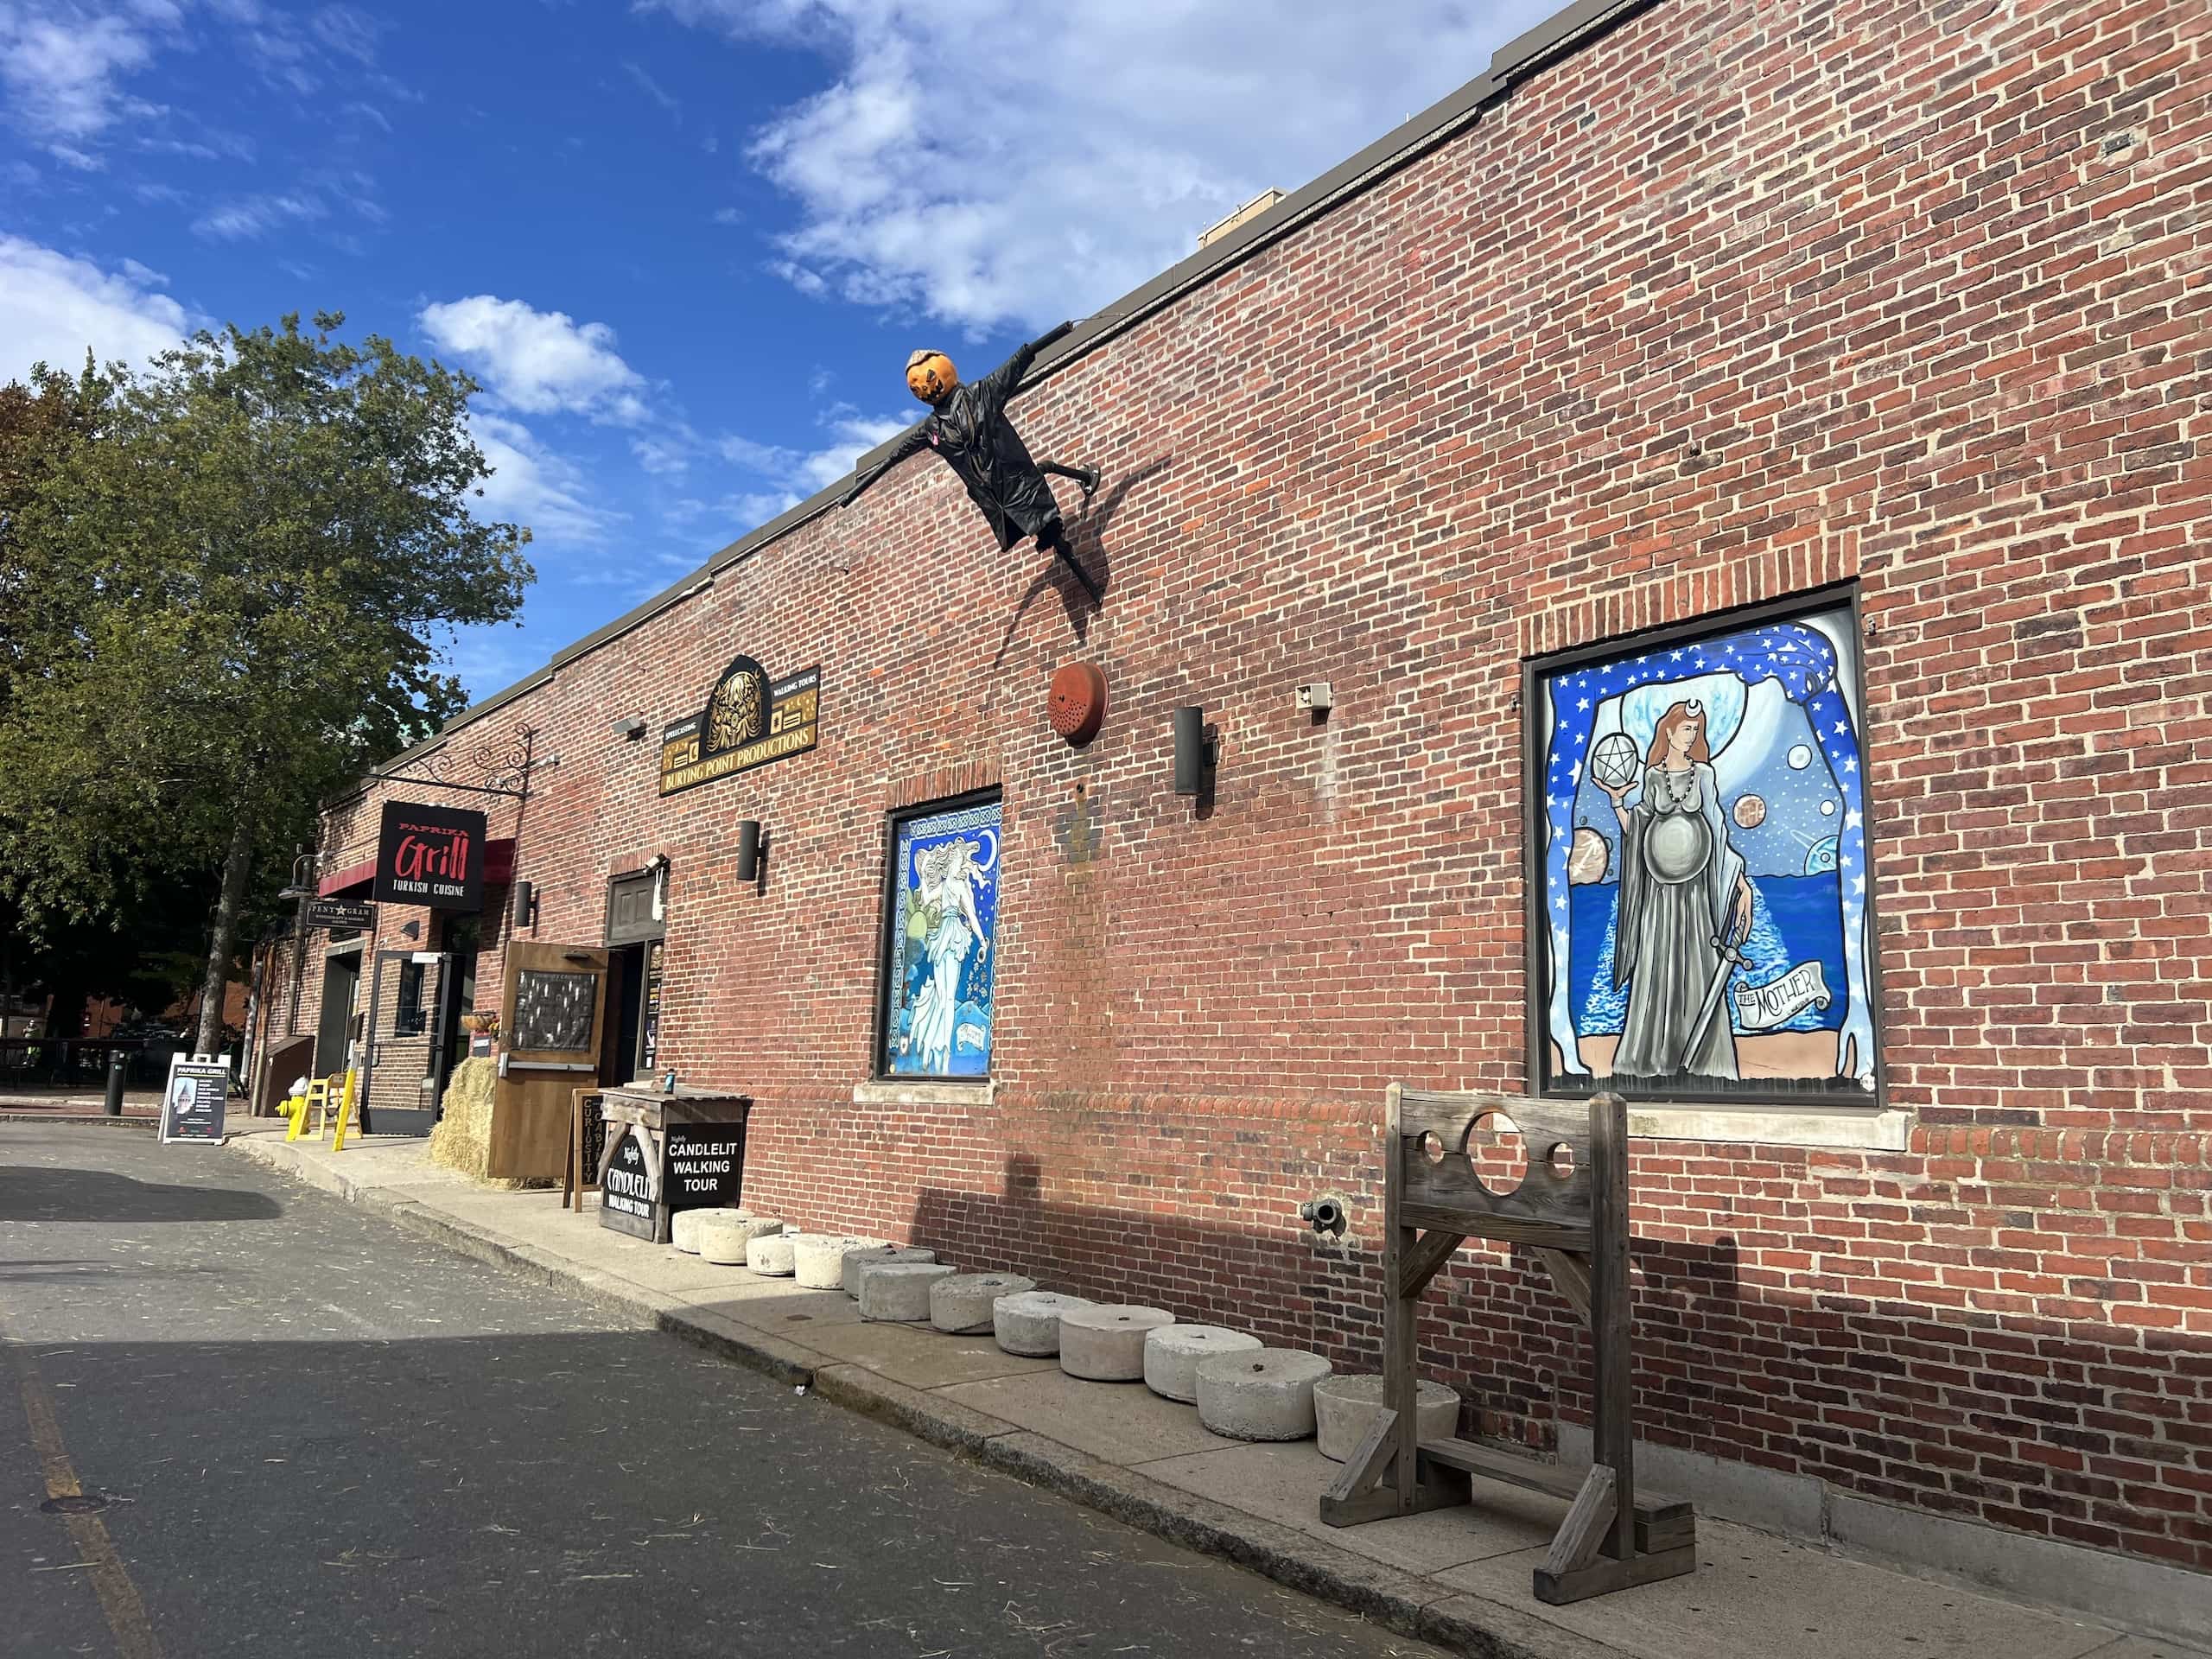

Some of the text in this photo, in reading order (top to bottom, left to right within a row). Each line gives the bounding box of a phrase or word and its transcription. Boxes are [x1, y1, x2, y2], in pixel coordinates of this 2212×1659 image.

[774, 682, 798, 696] WALKING
[665, 728, 809, 790] BURYING POINT PRODUCTIONS
[398, 823, 470, 837] PAPRIKA
[395, 835, 469, 881] Grill
[393, 880, 465, 897] TURKISH CUISINE
[1738, 995, 1756, 1004] THE
[1755, 969, 1815, 1024] MOTHER
[584, 1098, 593, 1183] CURIOSITY
[669, 1142, 737, 1156] CANDLELIT
[673, 1160, 730, 1174] WALKING
[683, 1178, 718, 1192] TOUR
[608, 1194, 650, 1218] WALKING TOUR
